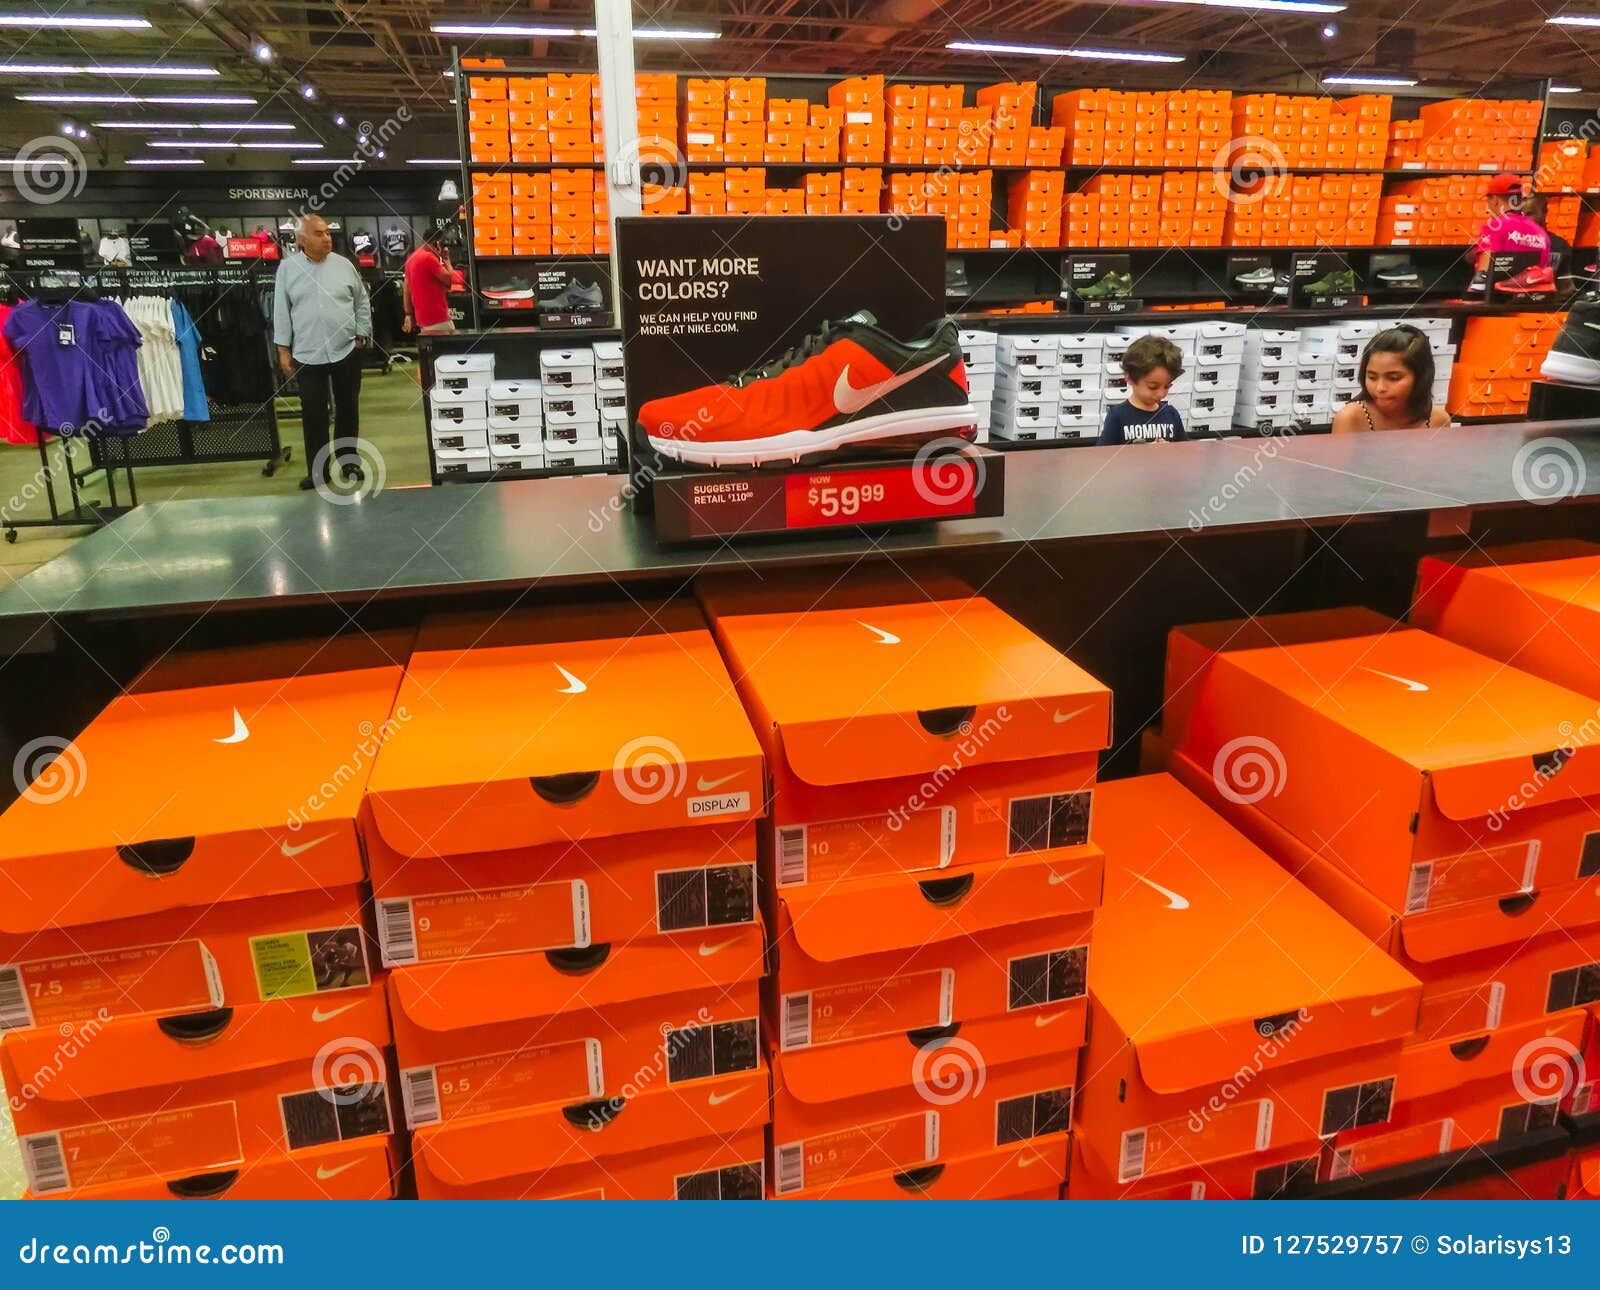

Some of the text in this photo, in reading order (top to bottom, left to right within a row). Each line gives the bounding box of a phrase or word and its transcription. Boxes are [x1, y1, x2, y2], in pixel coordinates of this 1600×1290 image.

[229, 188, 309, 199] SPORTSWEAR
[636, 257, 760, 278] WANT MORE
[638, 281, 730, 301] COLORS?
[639, 311, 758, 324] WE CAN HELP YOU FIND
[640, 323, 740, 336] MORE AT NIKE.COM.
[1123, 423, 1175, 441] MOMMY'S
[810, 475, 832, 485] NOW
[693, 482, 749, 495] SUGGESTED
[694, 494, 727, 505] RETAIL
[692, 797, 741, 813] DISPLAY
[810, 841, 829, 856] 10
[417, 916, 432, 932] 9
[30, 980, 64, 998] 7.5
[815, 1005, 833, 1020] 10
[441, 1078, 471, 1095] 9.5
[68, 1147, 81, 1161] 7
